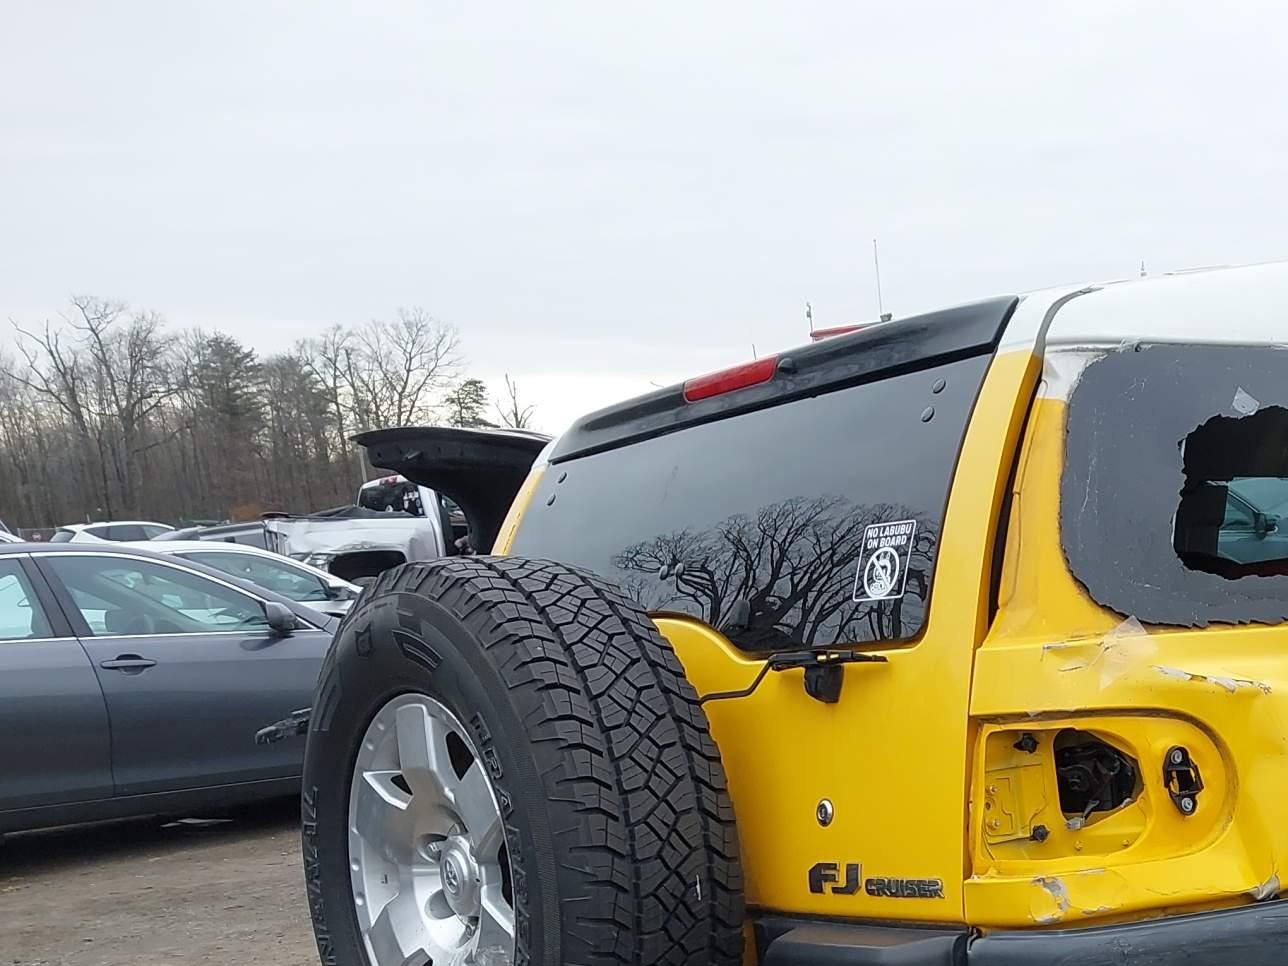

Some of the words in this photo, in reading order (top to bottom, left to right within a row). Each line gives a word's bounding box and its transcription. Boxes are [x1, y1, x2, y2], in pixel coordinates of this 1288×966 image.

[866, 528, 879, 539] NO
[879, 523, 912, 537] LABUBU
[867, 538, 879, 549] ON
[879, 535, 907, 548] BOARD
[808, 862, 862, 895] FJ
[864, 878, 945, 899] CRUISER
